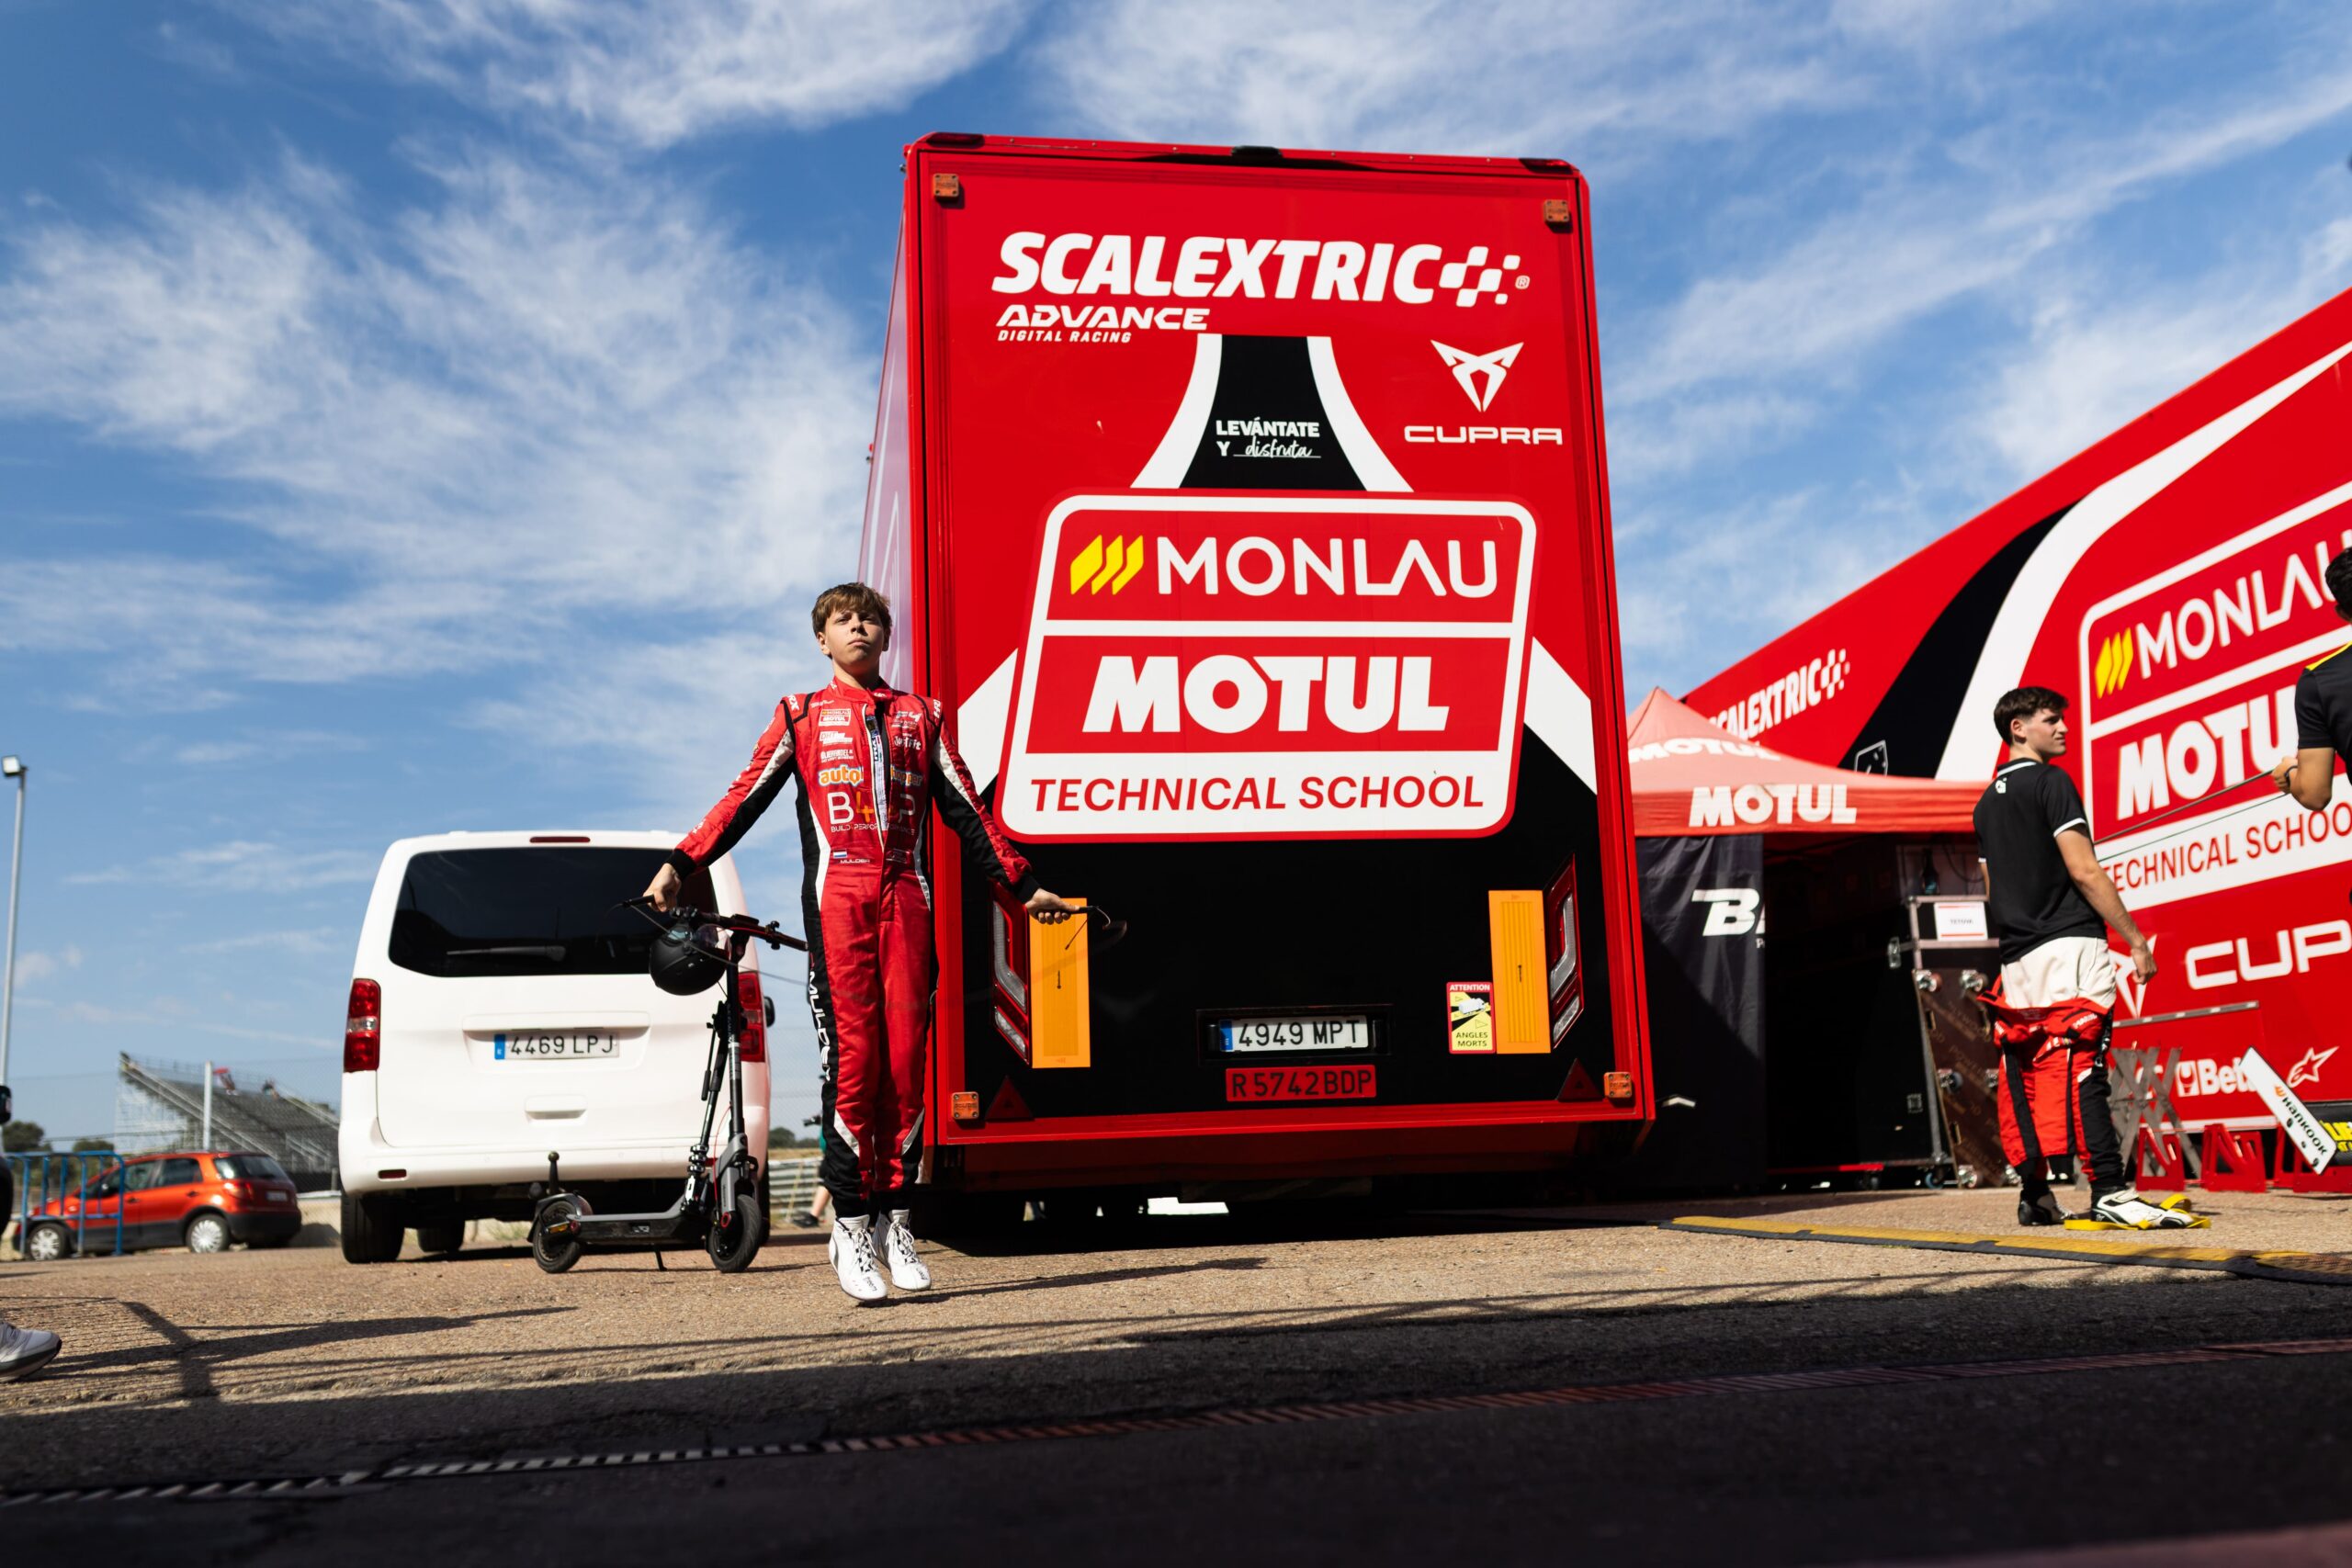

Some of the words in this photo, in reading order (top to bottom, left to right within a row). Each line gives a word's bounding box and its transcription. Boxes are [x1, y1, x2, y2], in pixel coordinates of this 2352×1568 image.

[991, 231, 1442, 305] SCALEXTRIC
[996, 304, 1210, 330] ADVANCE
[998, 330, 1062, 342] DIGITAL
[1069, 332, 1132, 344] RACING
[1216, 416, 1320, 437] LEVÁNTATE
[1405, 426, 1563, 446] CUPRA
[1216, 441, 1231, 457] Y
[1245, 434, 1313, 458] disfruta
[1157, 536, 1498, 598] MONLAU
[1082, 655, 1450, 734] MOTUL
[1030, 778, 1286, 812] TECHNICAL
[1298, 775, 1484, 809] SCHOOL
[1689, 784, 1858, 828] MOTUL
[511, 1035, 565, 1055] 4469
[573, 1034, 614, 1054] LPJ
[1238, 1022, 1304, 1046] 4949
[1313, 1020, 1361, 1044] MPT
